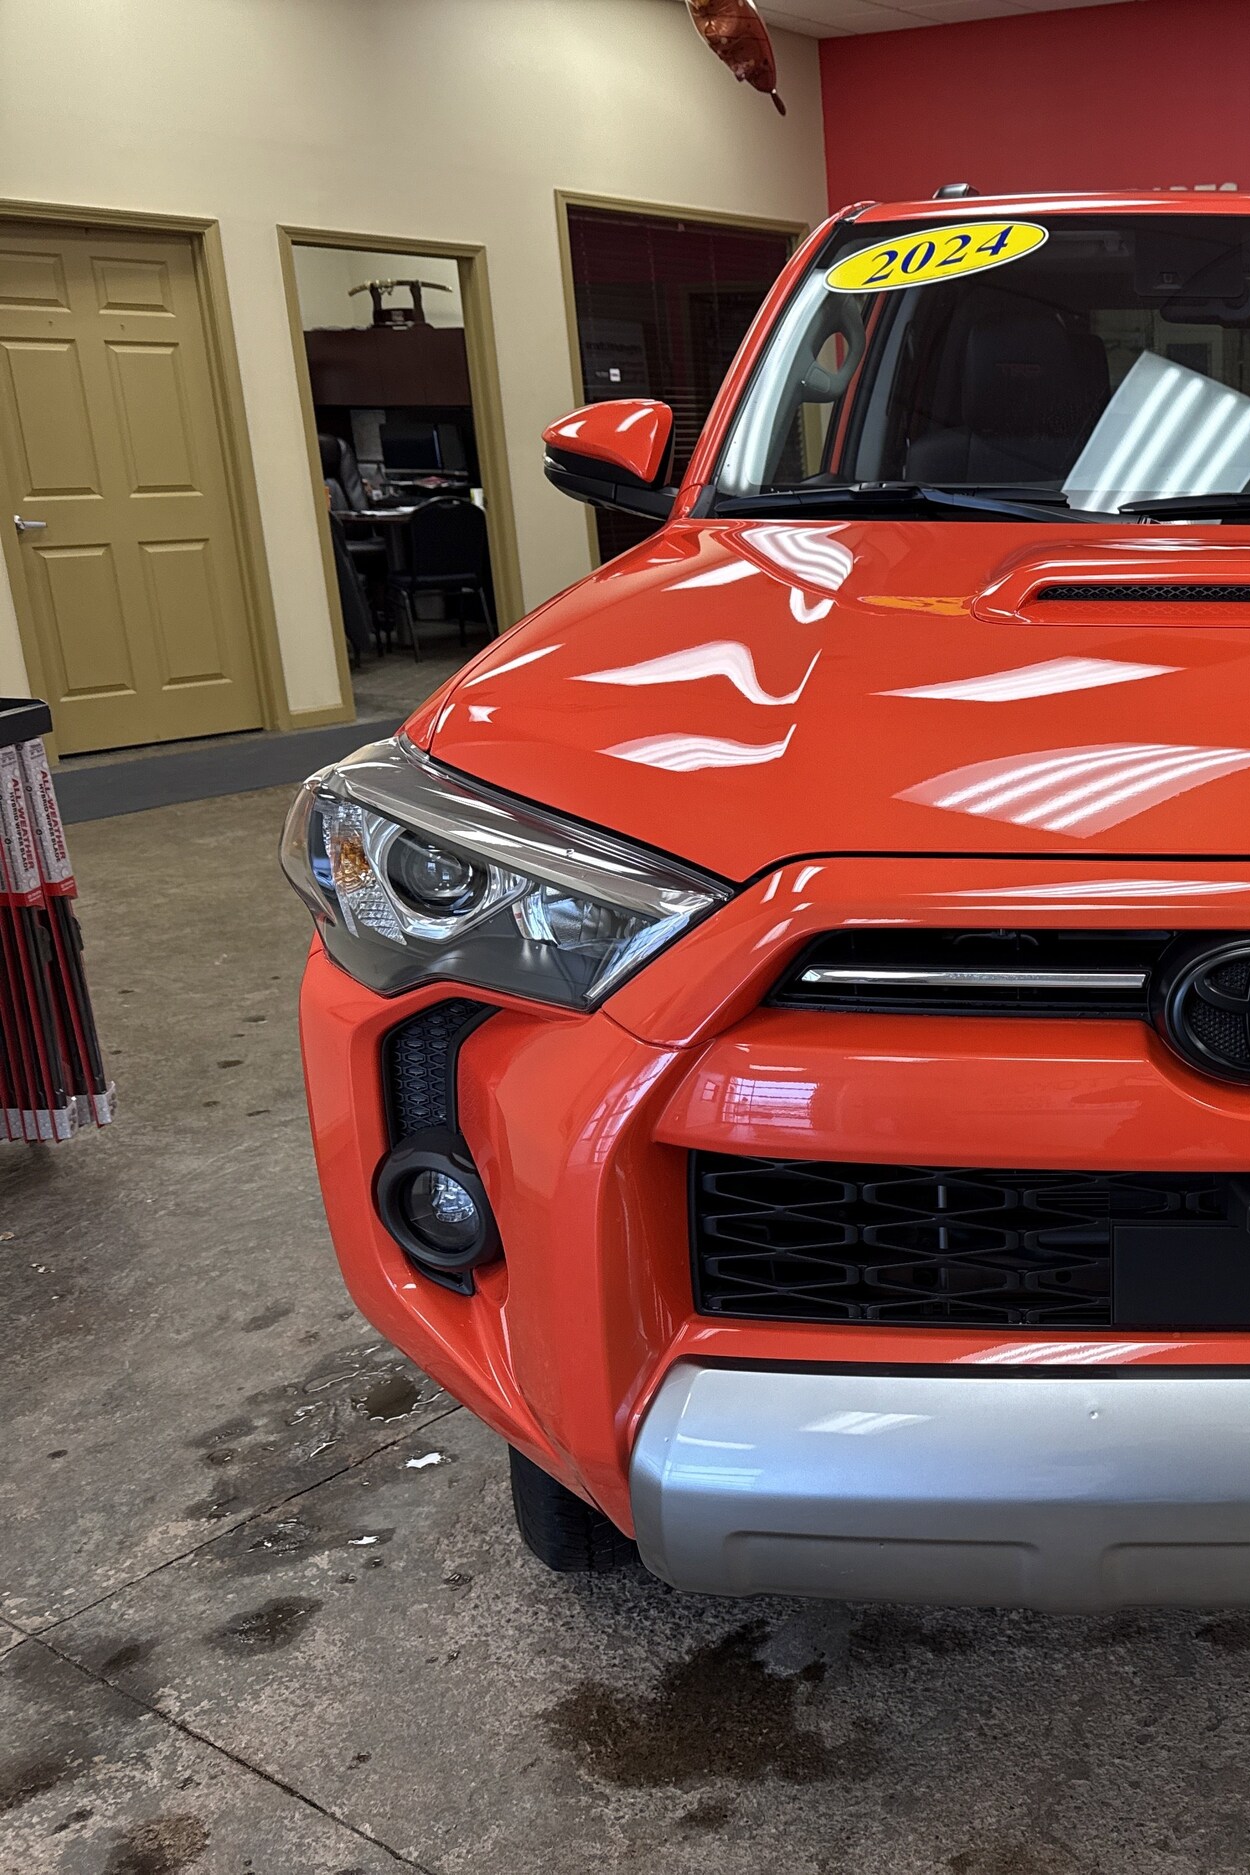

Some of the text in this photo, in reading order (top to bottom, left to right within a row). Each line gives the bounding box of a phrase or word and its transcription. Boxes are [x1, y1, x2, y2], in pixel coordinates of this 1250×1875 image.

[861, 225, 1014, 286] 2024
[11, 778, 35, 870] ALL-WEATHER
[38, 783, 49, 812] HYBRID
[40, 770, 67, 860] ALL-WEATHER
[45, 812, 56, 836] WIPER
[9, 792, 29, 873] HYBRID WIPER BLADE
[50, 837, 61, 863] BLADE
